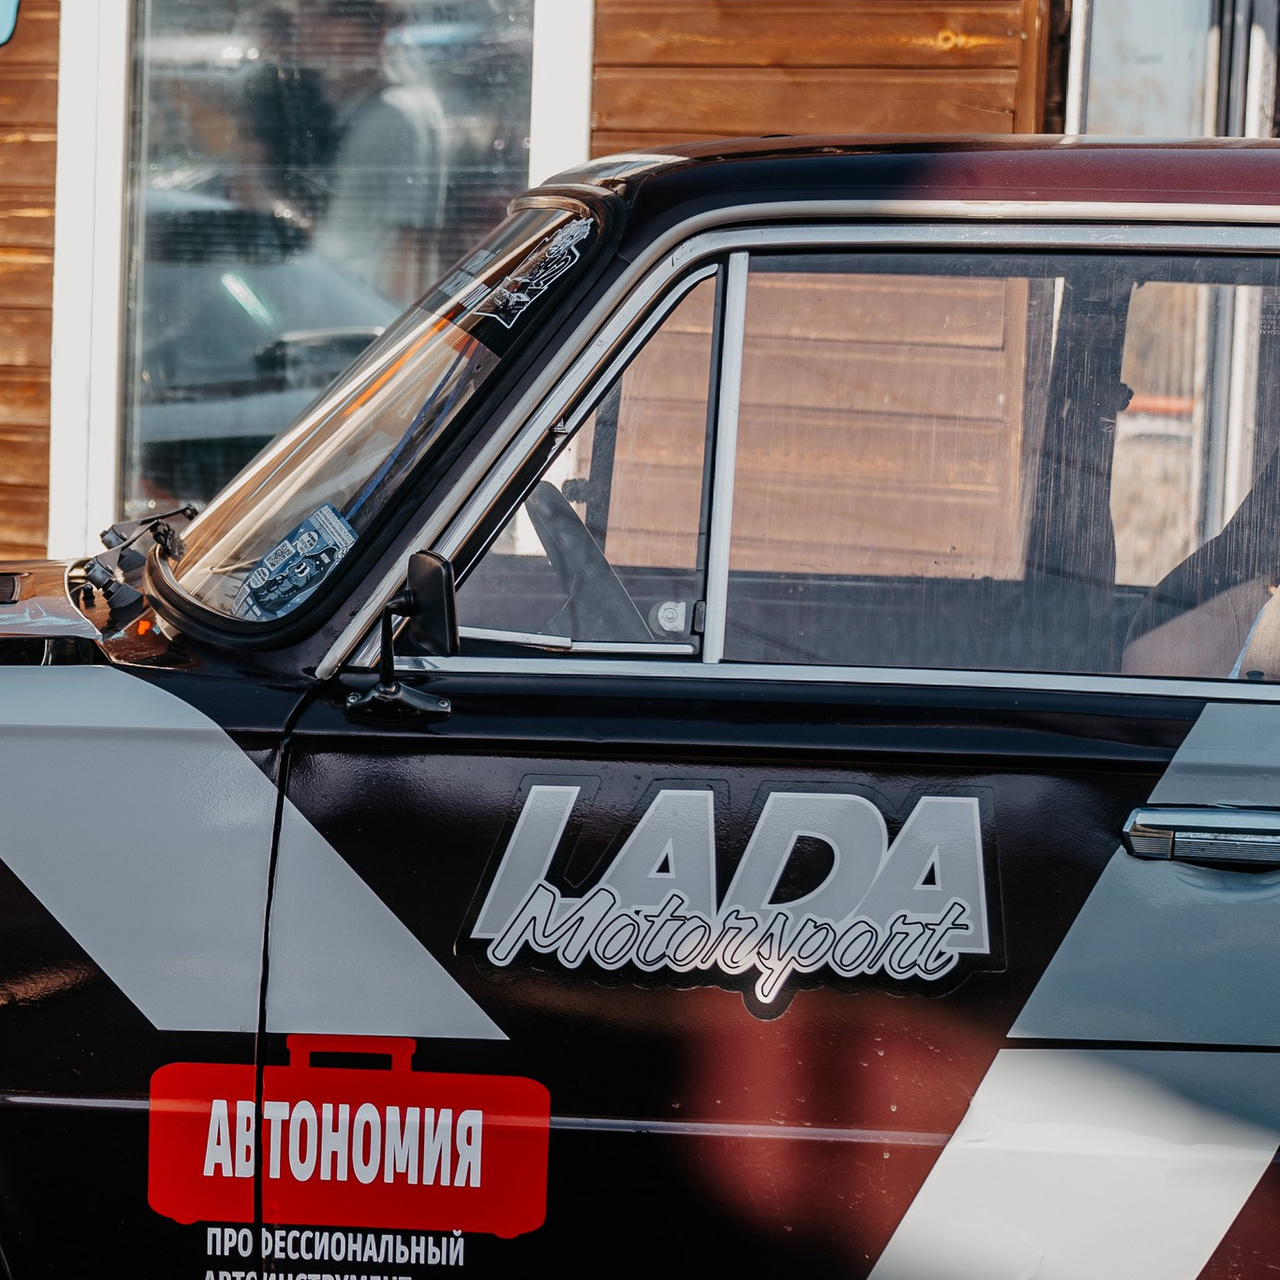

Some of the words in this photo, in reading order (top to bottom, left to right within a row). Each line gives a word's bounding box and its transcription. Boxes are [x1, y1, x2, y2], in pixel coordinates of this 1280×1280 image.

[470, 785, 990, 954] LADA
[487, 879, 973, 1003] Motorsport
[203, 1099, 483, 1188] АВТОНОМИЯ
